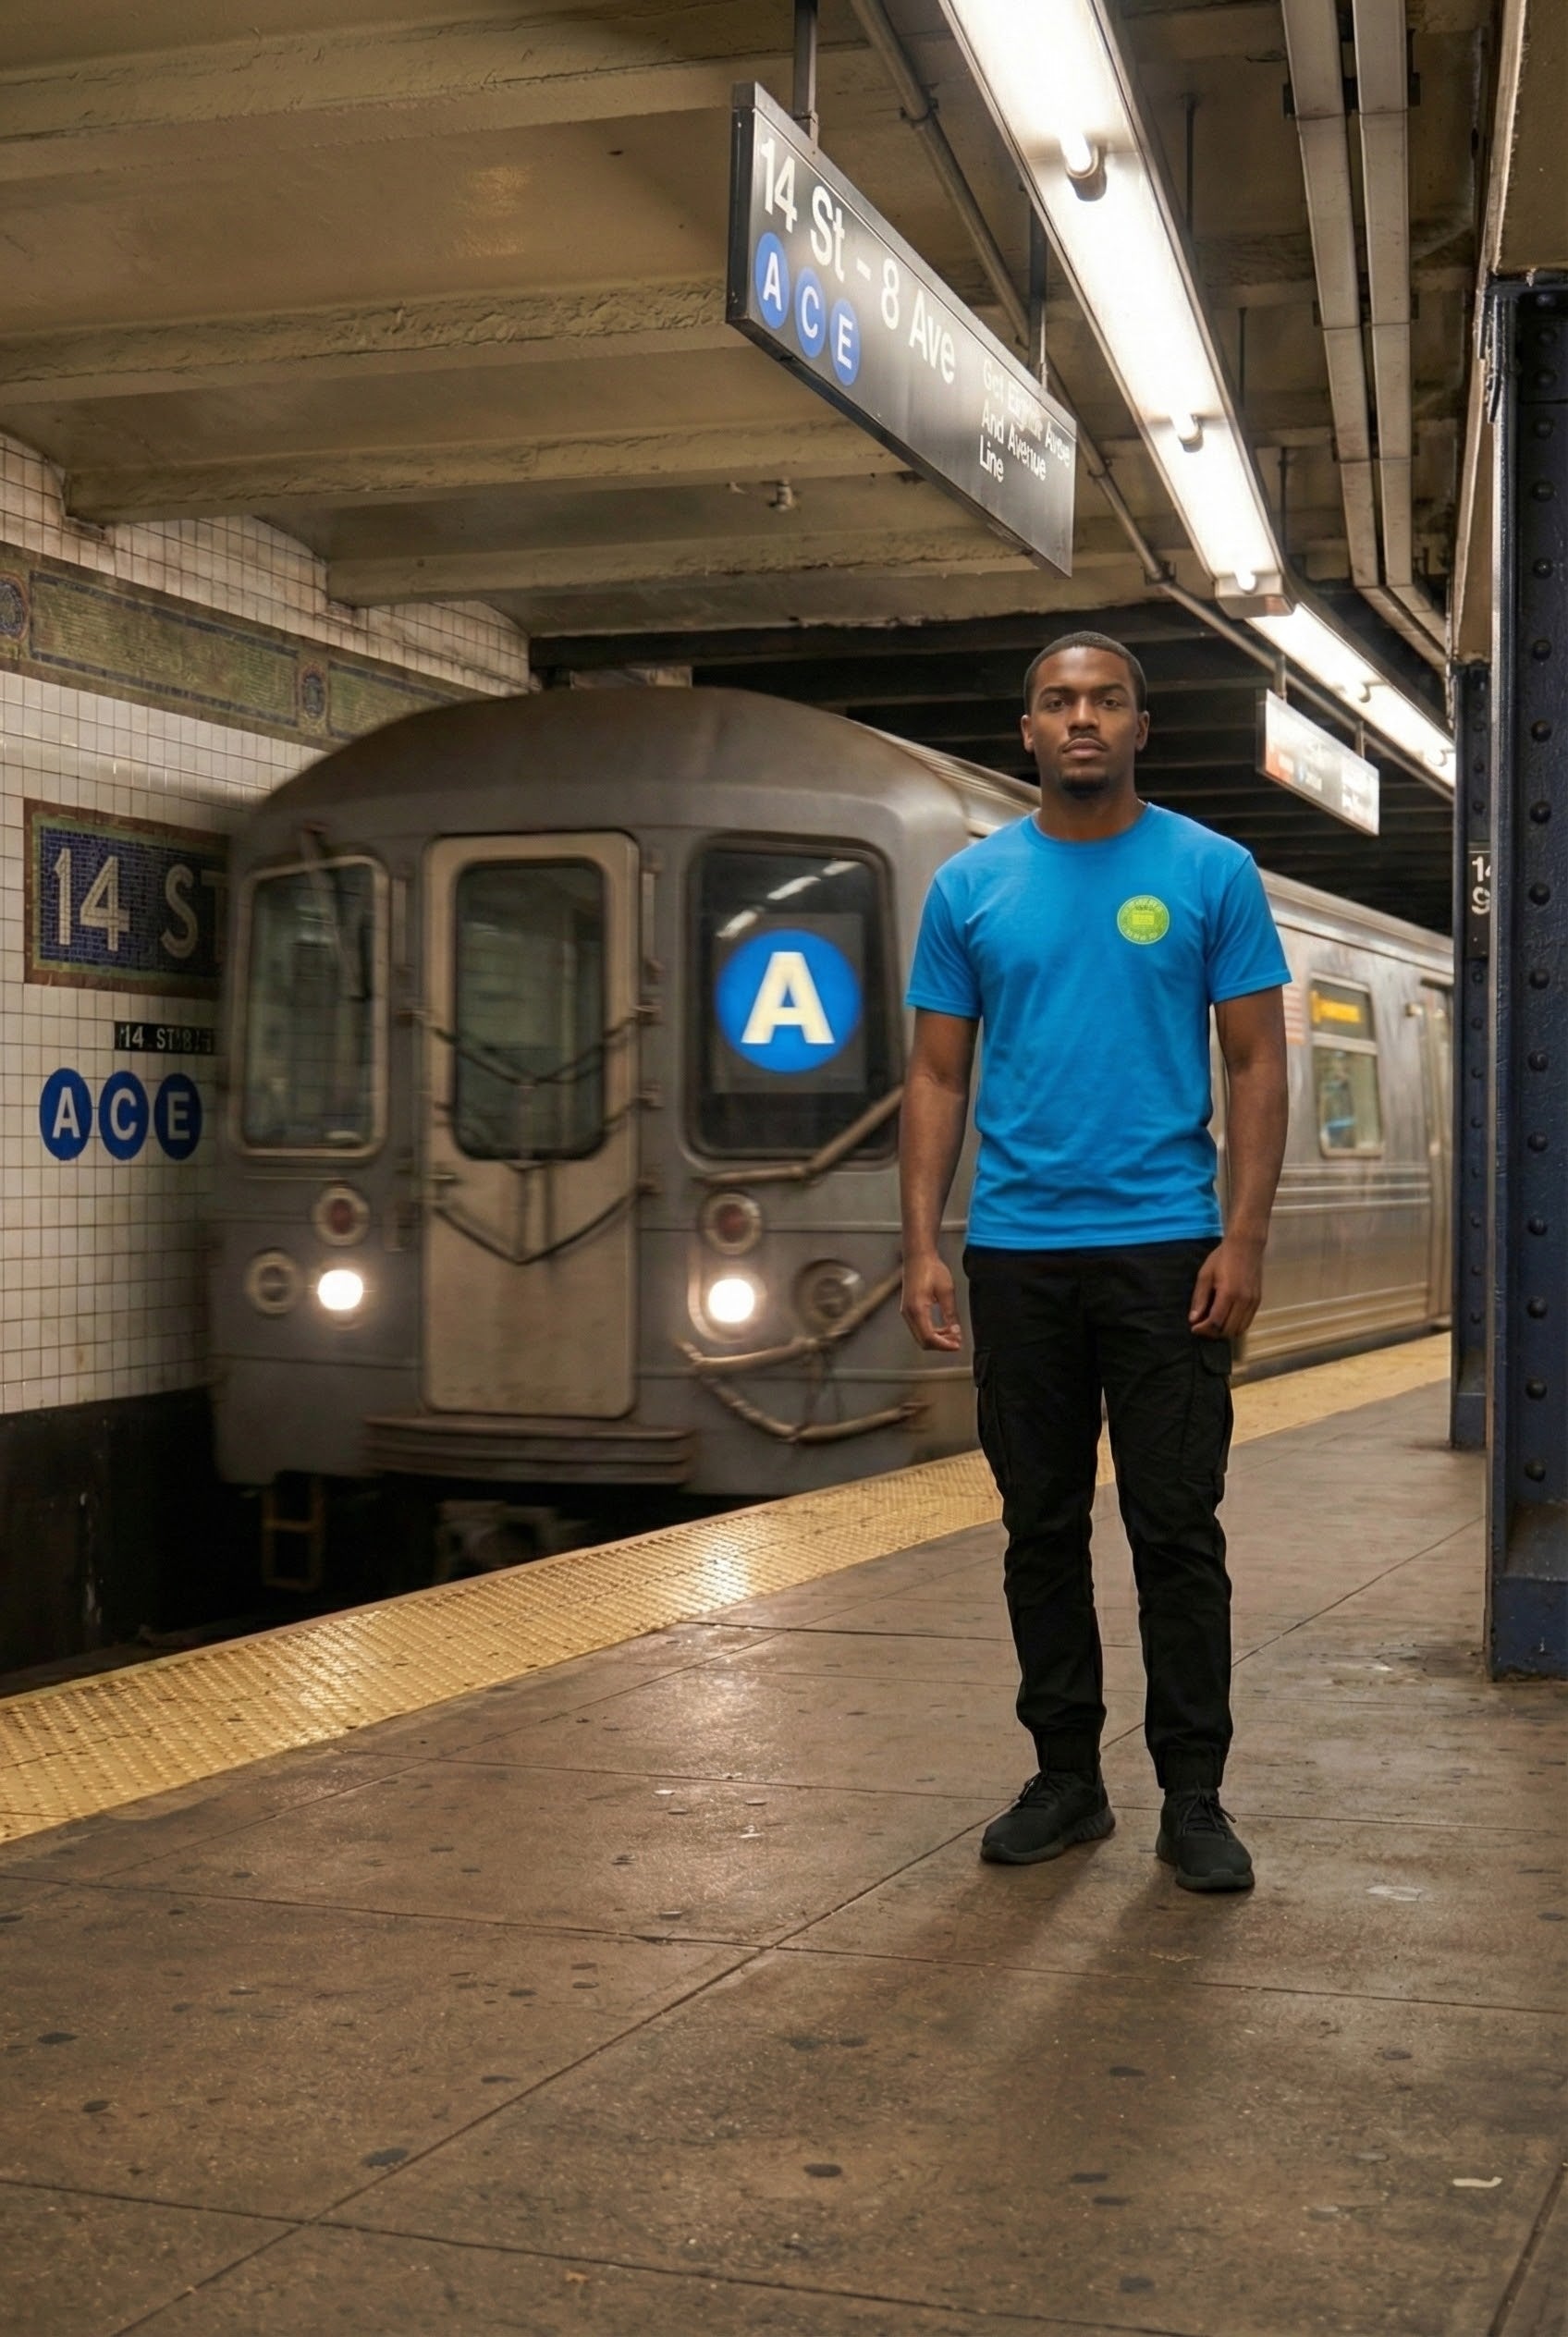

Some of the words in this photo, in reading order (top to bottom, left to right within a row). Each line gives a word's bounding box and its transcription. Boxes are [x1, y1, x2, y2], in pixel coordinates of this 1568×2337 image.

[760, 138, 798, 233] 14
[810, 186, 845, 283] St
[881, 258, 900, 330] 8
[909, 288, 955, 385] Ave
[763, 251, 782, 312] A
[802, 286, 819, 338] C
[838, 312, 853, 370] E
[980, 434, 1004, 483] Line
[982, 399, 1004, 444] And
[54, 848, 129, 951] 14
[741, 951, 835, 1045] A
[52, 1087, 80, 1138] A
[110, 1088, 137, 1140] C
[167, 1091, 190, 1140] E
